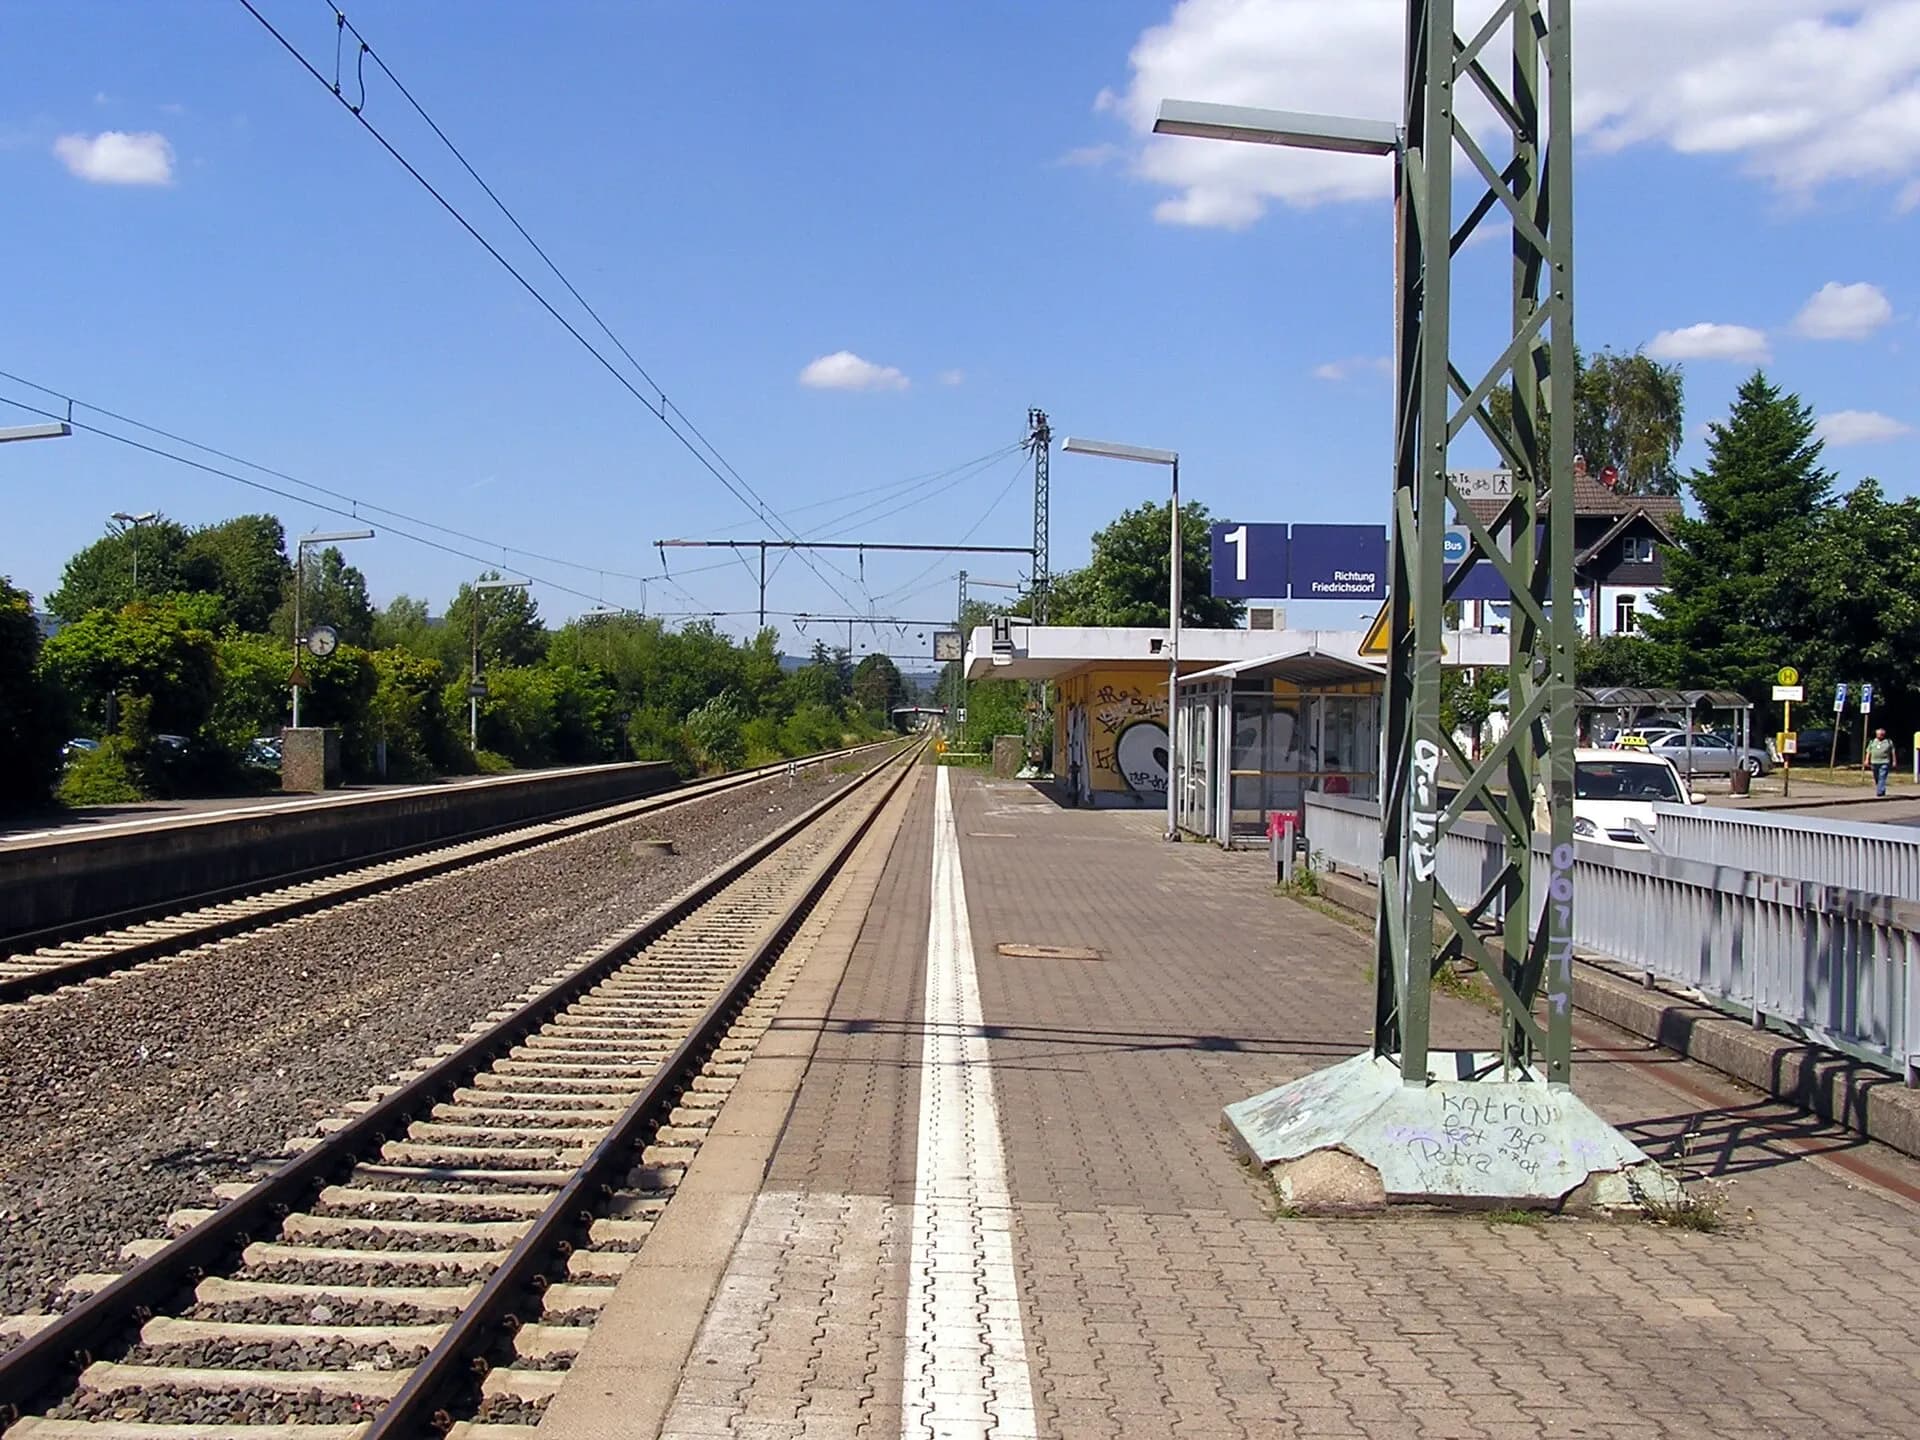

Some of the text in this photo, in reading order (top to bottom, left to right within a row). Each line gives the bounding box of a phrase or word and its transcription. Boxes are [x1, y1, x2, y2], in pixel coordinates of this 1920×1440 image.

[1224, 525, 1247, 580] 1
[1444, 541, 1462, 551] Bus
[1334, 571, 1375, 583] Richtung
[994, 618, 1009, 640] H
